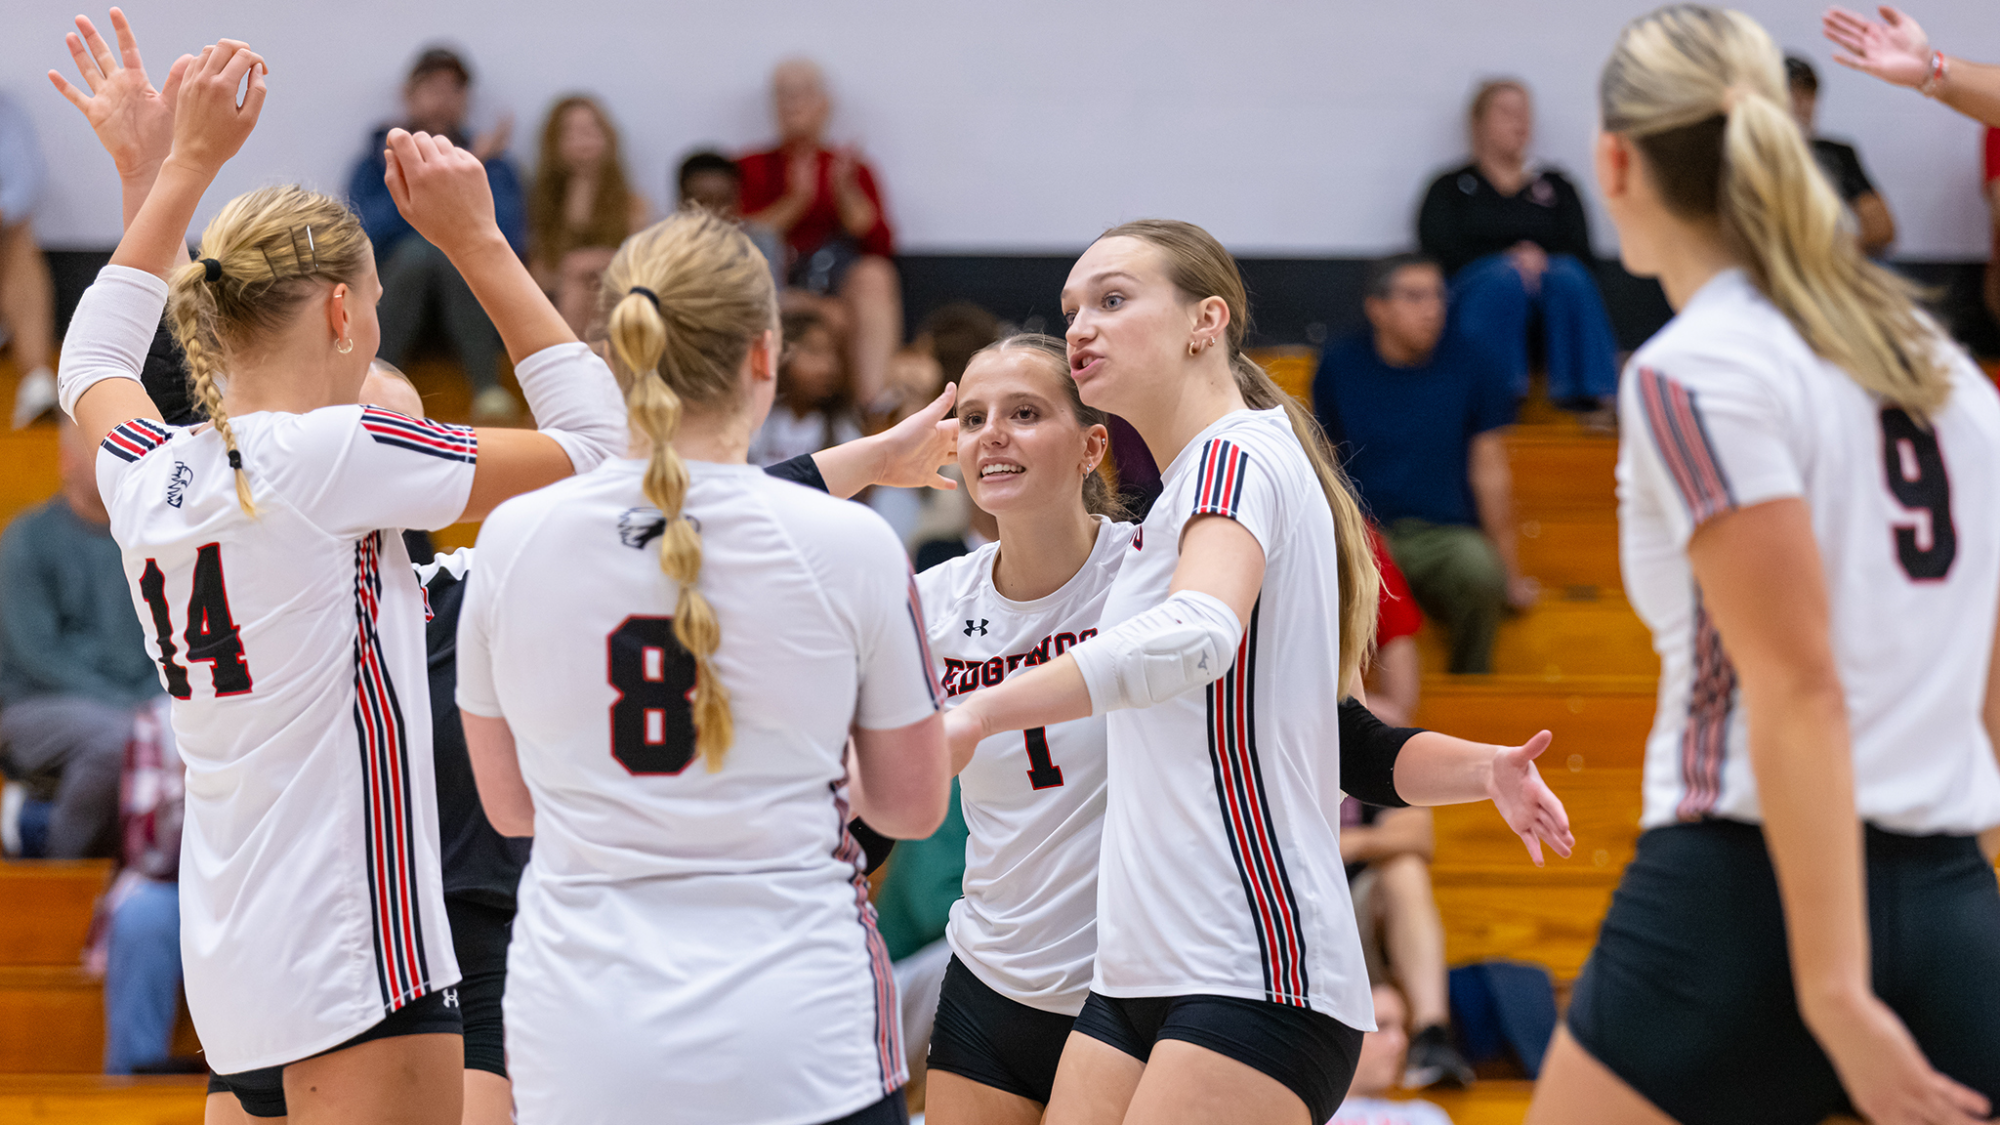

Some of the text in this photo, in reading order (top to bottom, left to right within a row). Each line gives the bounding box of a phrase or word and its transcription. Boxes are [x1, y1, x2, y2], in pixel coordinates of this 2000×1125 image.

[1879, 403, 1959, 586] 9
[139, 542, 253, 700] 14
[606, 613, 702, 777] 8
[1023, 726, 1064, 790] 1
